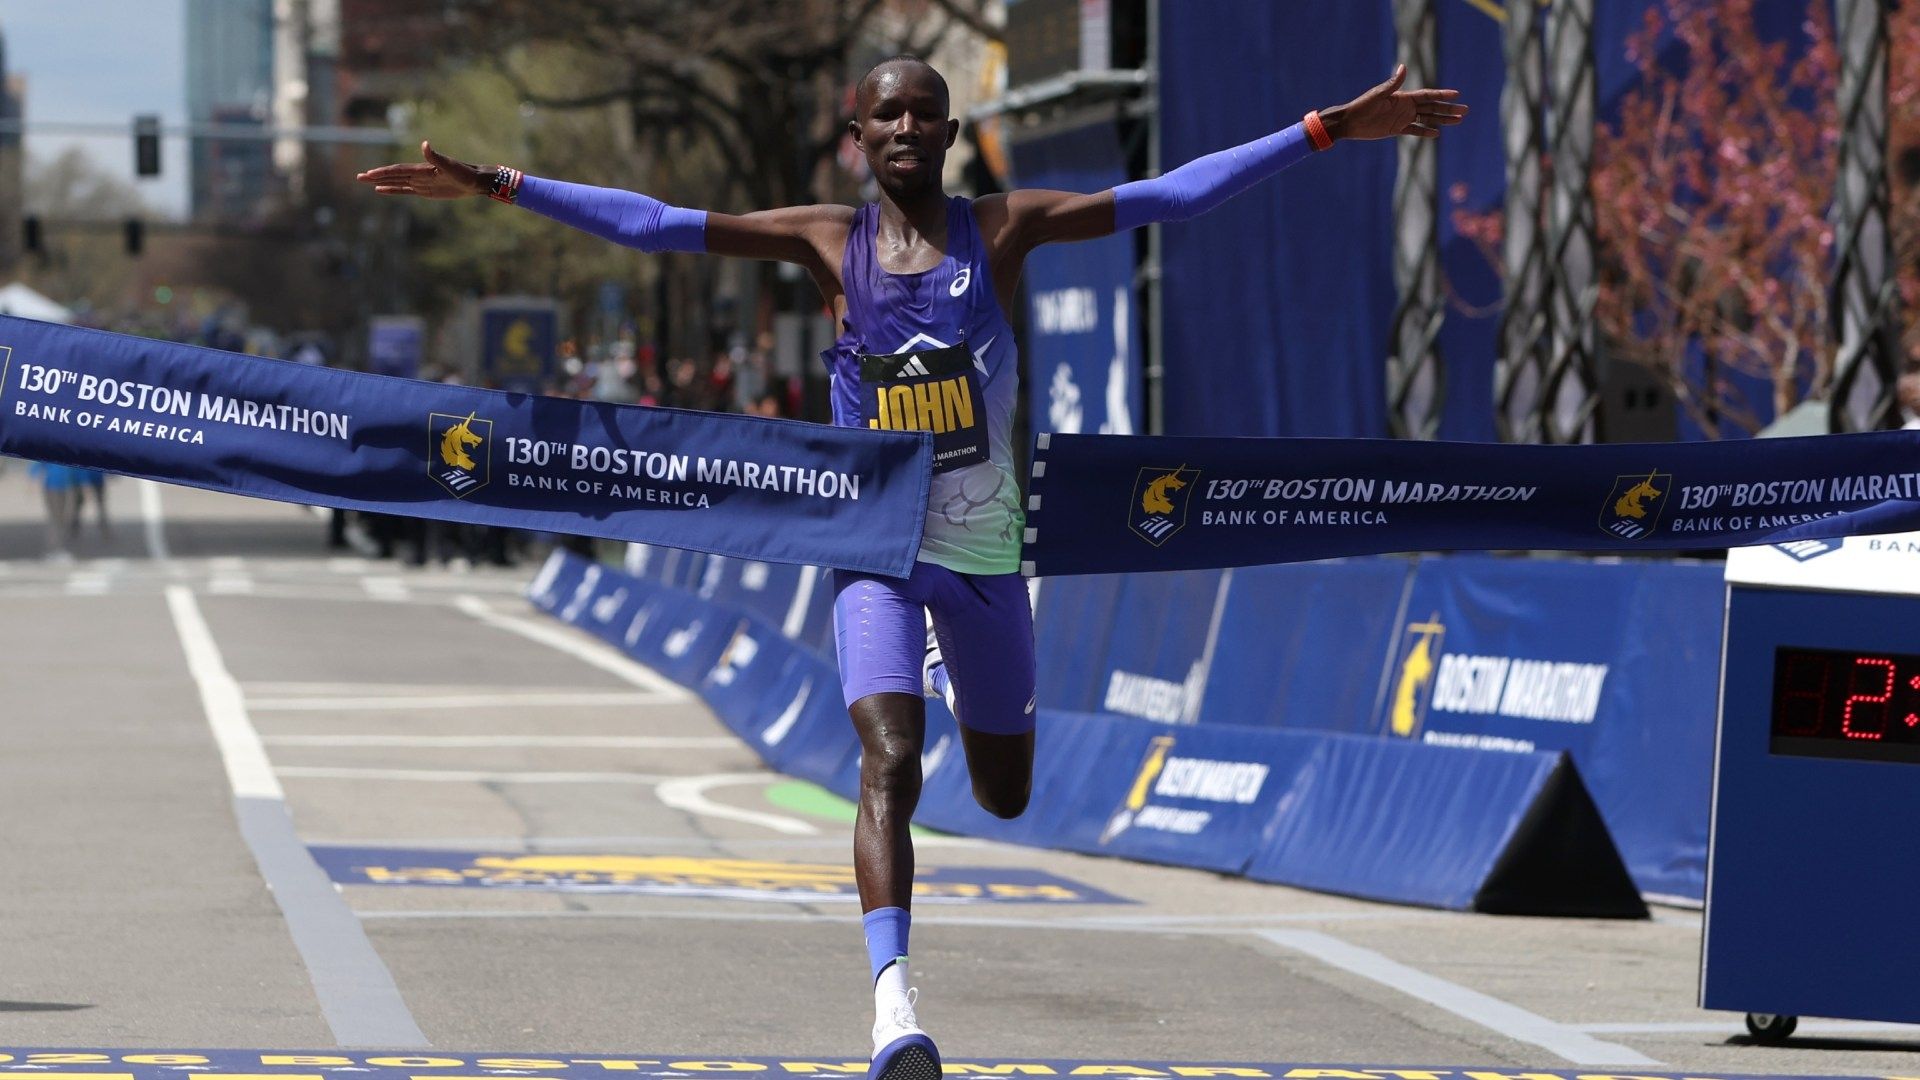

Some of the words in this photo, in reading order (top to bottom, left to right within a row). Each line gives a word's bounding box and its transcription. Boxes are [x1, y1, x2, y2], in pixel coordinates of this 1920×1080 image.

[78, 374, 192, 417] BOSTON
[198, 394, 348, 440] MARATHON
[869, 376, 975, 434] JOHN
[15, 401, 72, 424] BANK
[76, 411, 106, 429] OF
[107, 417, 205, 445] AMERICA
[937, 445, 977, 461] MARATHON
[571, 444, 689, 482] BOSTON
[697, 457, 860, 500] MARATHON
[508, 473, 569, 492] BANK
[575, 480, 604, 495] OF
[609, 484, 710, 509] AMERICA
[1263, 477, 1375, 503] BOSTON
[1380, 480, 1537, 503] MARATHON
[1732, 478, 1825, 507] BOSTON
[1202, 510, 1257, 525] BANK
[1263, 510, 1288, 525] OF
[1293, 510, 1388, 525] AMERICA
[1672, 516, 1724, 532] BANK
[1729, 515, 1752, 531] OF
[1758, 510, 1847, 529] AMERIC
[0, 1053, 210, 1064] 26
[260, 1055, 870, 1073] BOSTON
